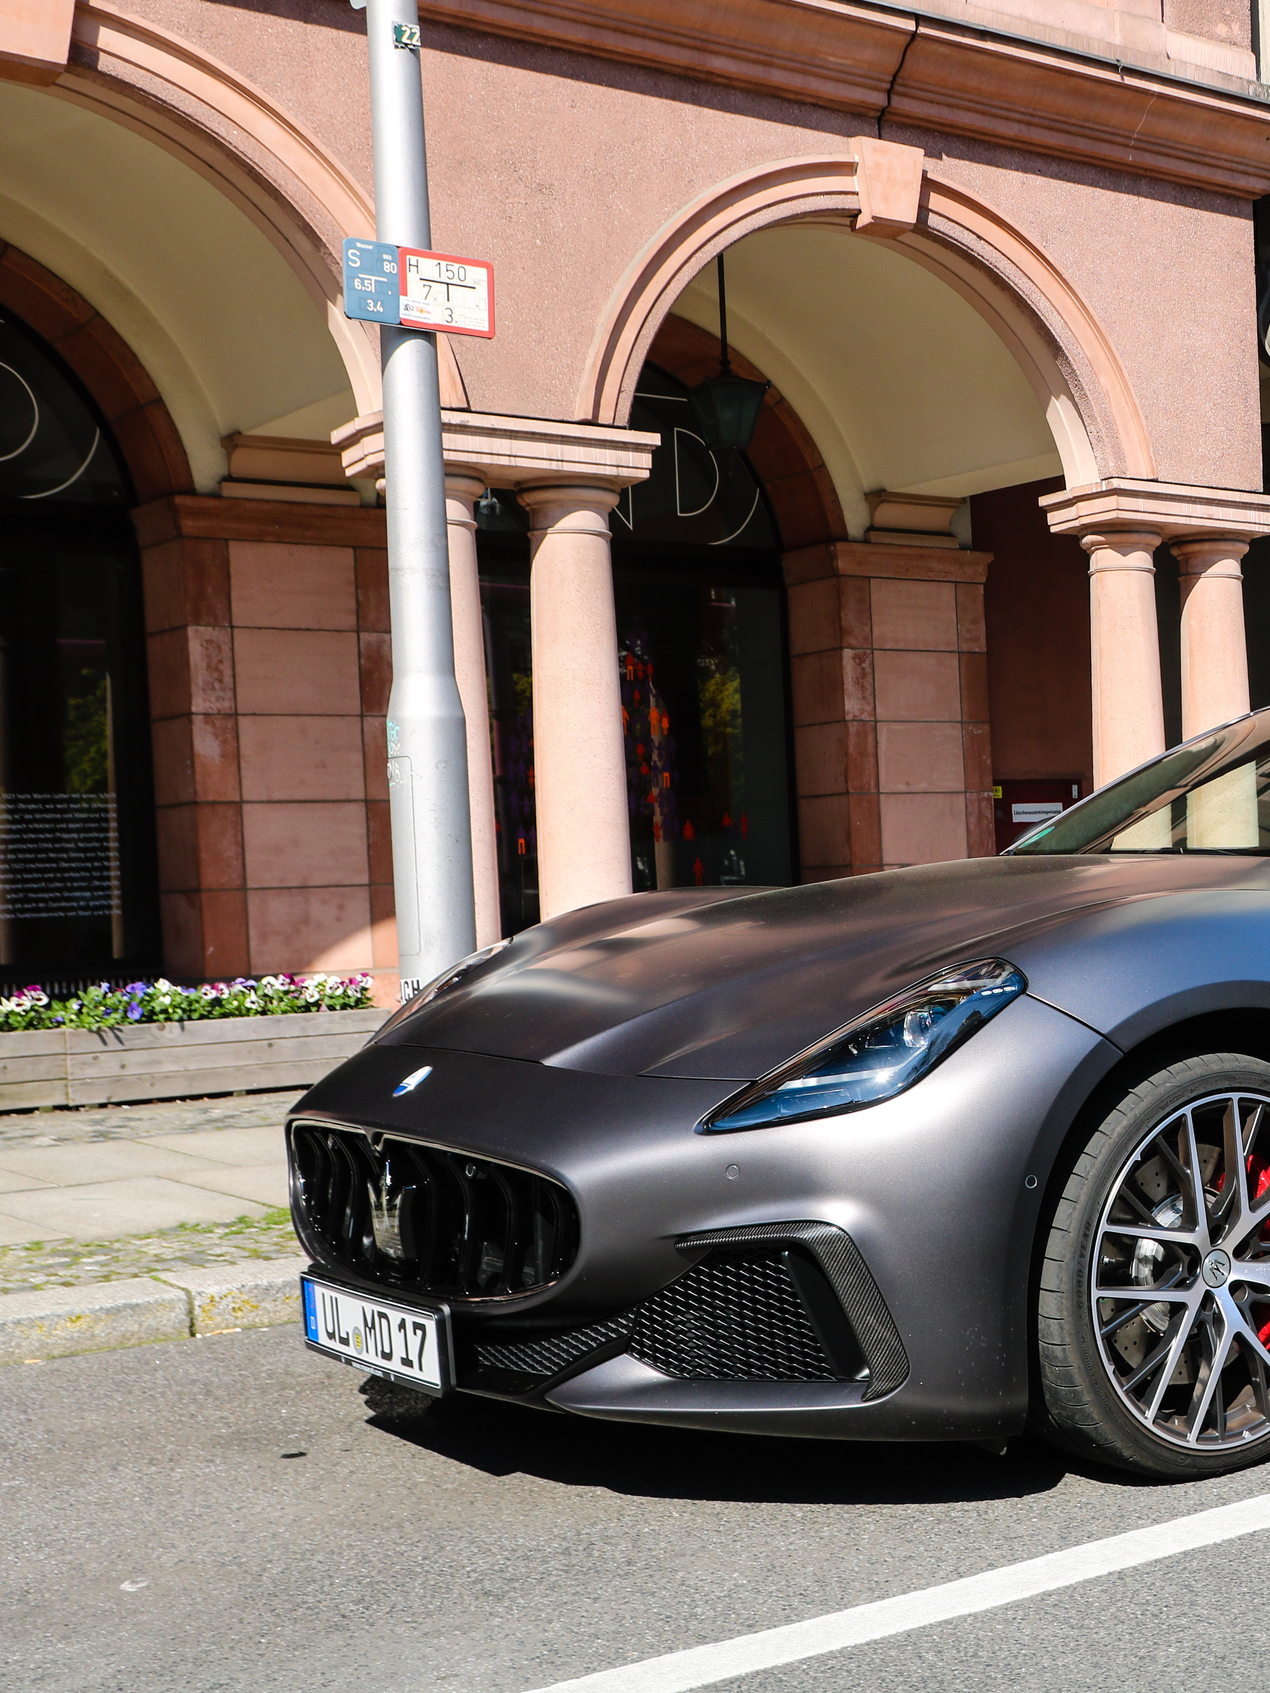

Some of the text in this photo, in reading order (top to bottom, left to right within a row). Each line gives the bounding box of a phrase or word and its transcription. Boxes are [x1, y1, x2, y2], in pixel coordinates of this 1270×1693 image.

[401, 25, 421, 46] 22
[347, 249, 361, 267] S
[383, 262, 398, 274] 80
[408, 257, 467, 282] H 150
[366, 299, 384, 313] 3.4
[321, 1292, 427, 1373] UL MD 17
